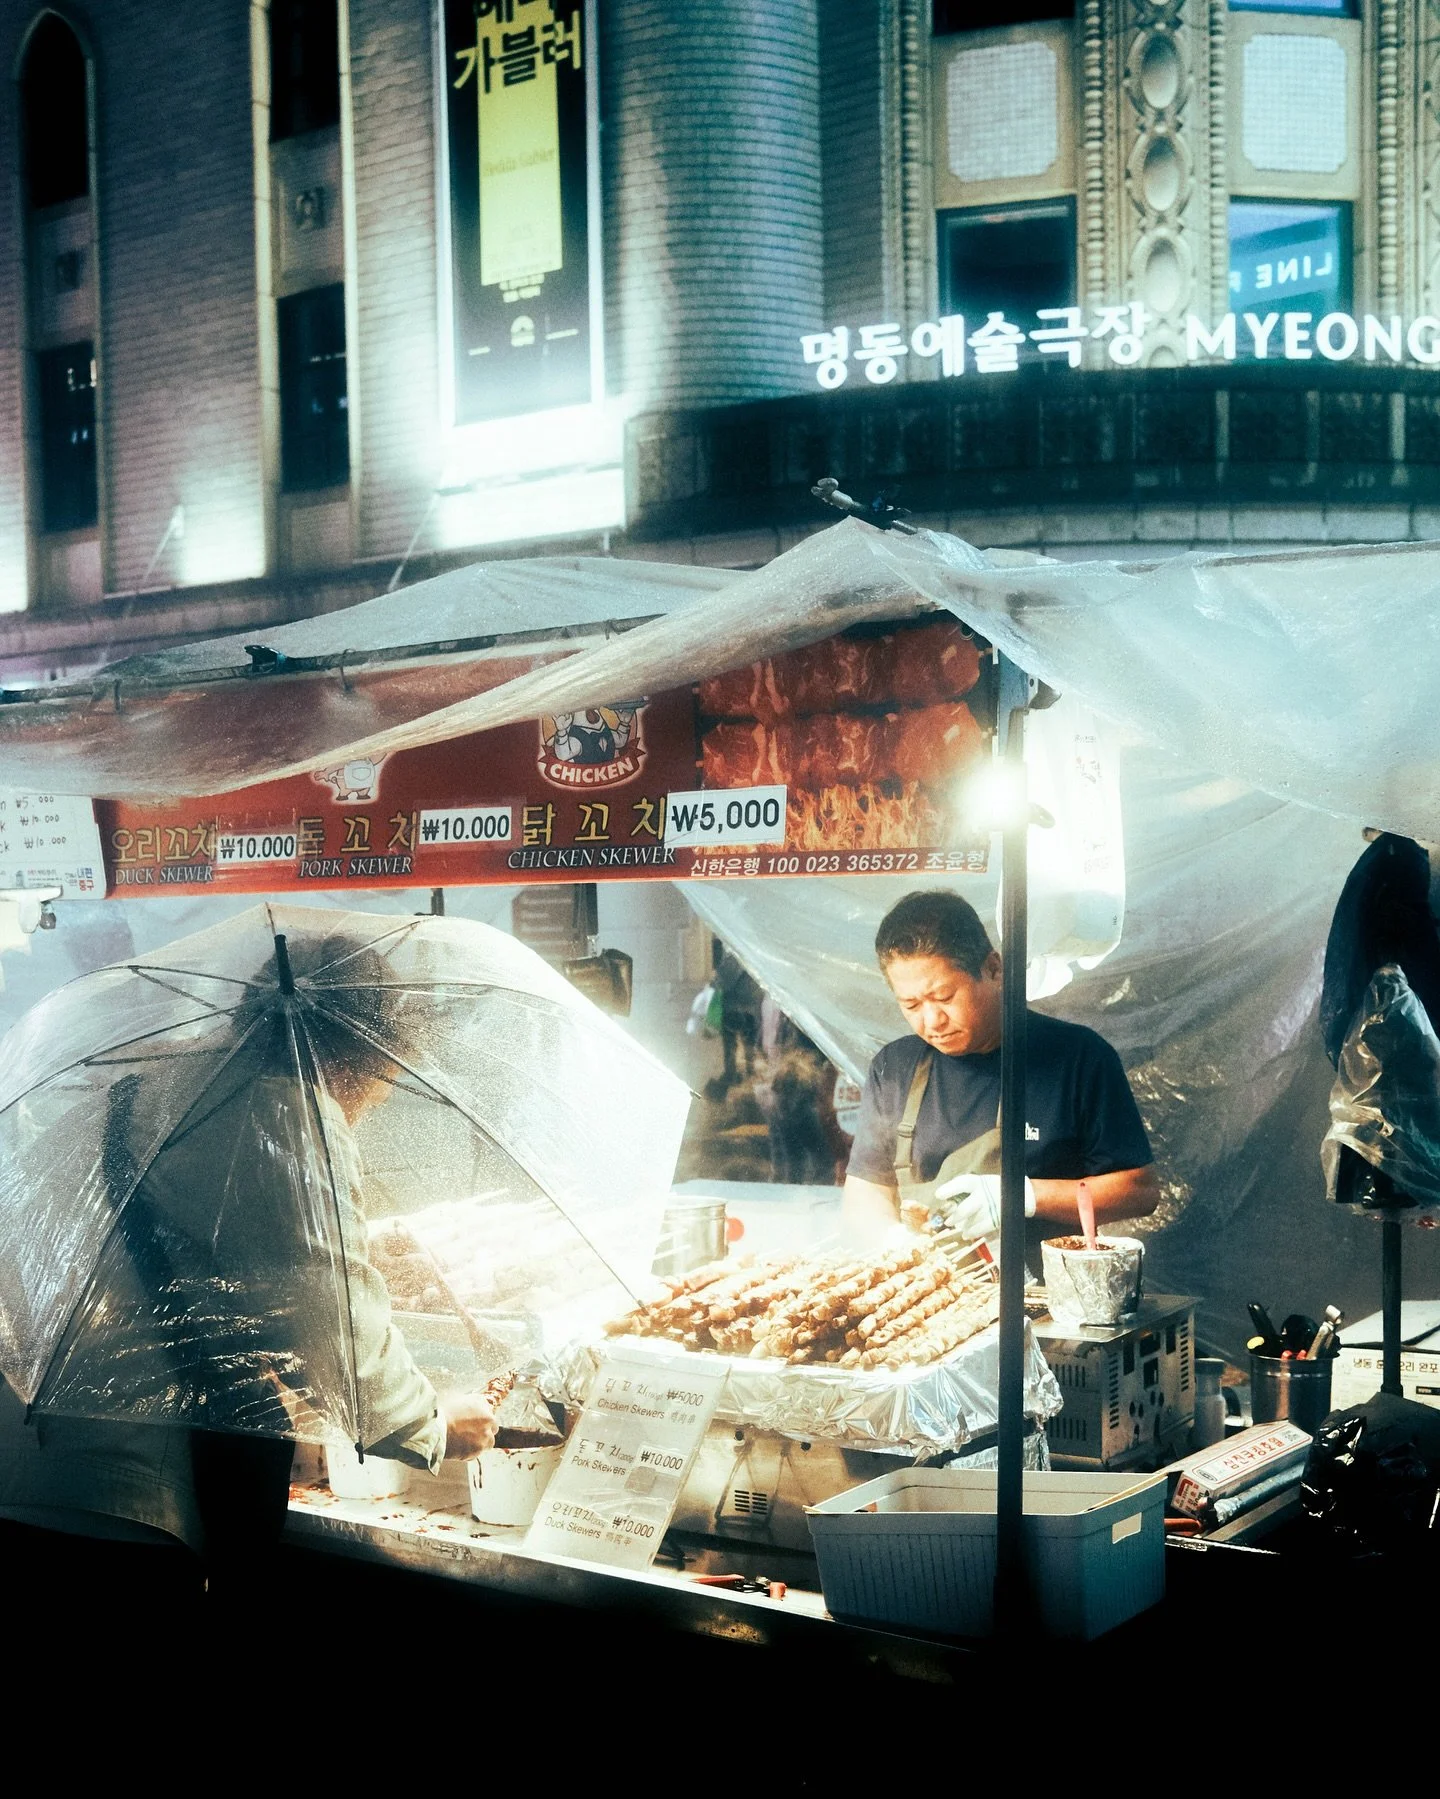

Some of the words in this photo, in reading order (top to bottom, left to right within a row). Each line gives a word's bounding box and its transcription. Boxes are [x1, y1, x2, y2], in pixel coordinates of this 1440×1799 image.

[453, 10, 581, 94] 가블러
[800, 301, 1152, 390] 명동예술극장
[1185, 311, 1440, 364] MYEONG
[550, 760, 634, 783] CHICKEN
[422, 814, 510, 841] ₩10.000
[671, 798, 780, 834] ₩5,000
[220, 835, 294, 859] ₩10.000
[508, 850, 593, 870] CHICKEN
[598, 846, 677, 866] SKEWER
[115, 867, 154, 885] DUCK
[160, 865, 213, 883] SKEWER
[300, 860, 342, 877] PORK
[349, 857, 412, 876] SKEWER
[690, 857, 759, 877] 신한은행
[767, 857, 800, 873] 100
[806, 856, 840, 872] 023
[847, 853, 919, 871] 365372
[597, 1398, 630, 1413] Chicken
[630, 1404, 665, 1420] Skewers
[571, 1455, 589, 1469] Pork
[592, 1459, 627, 1476] Skewers
[640, 1450, 684, 1470] ₩10.000
[545, 1516, 564, 1530] Duck
[566, 1521, 601, 1539] Skewers
[612, 1515, 655, 1538] ₩10.000
